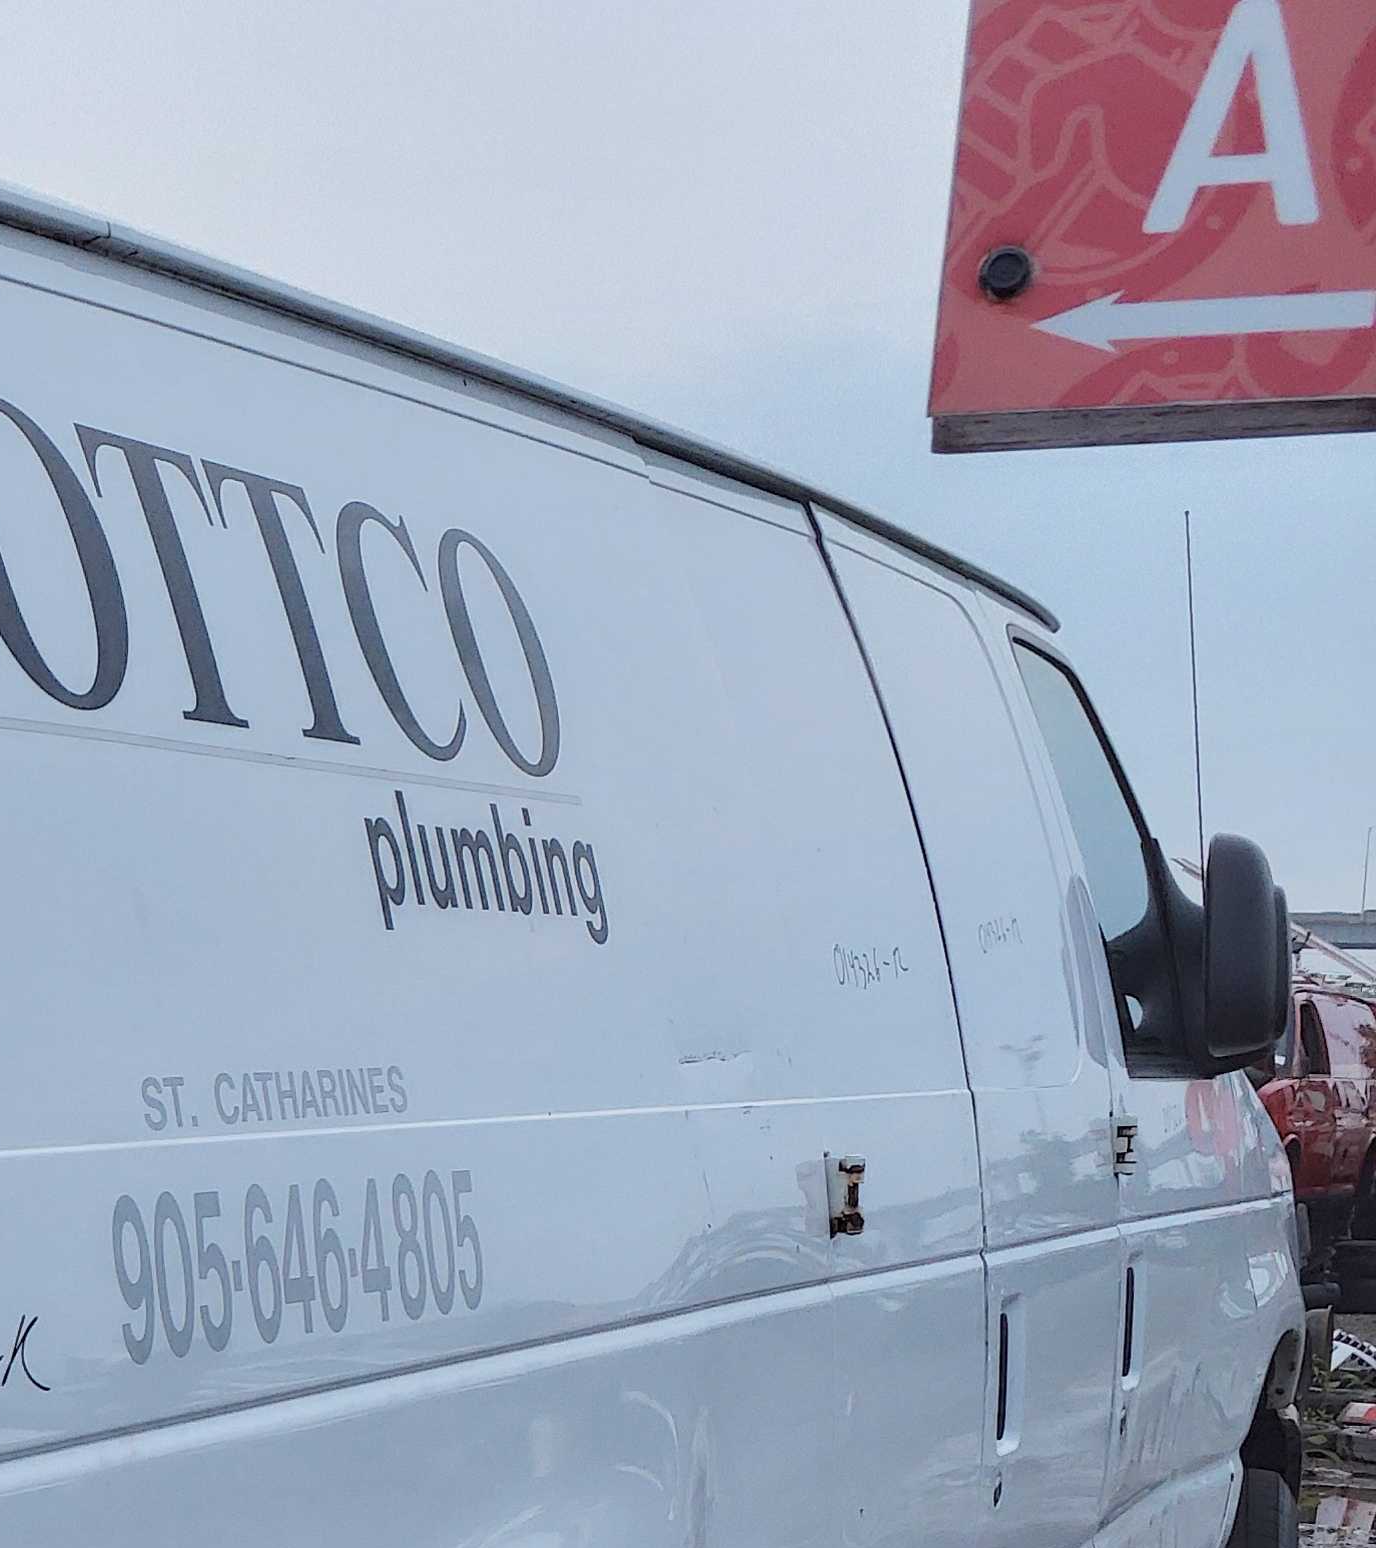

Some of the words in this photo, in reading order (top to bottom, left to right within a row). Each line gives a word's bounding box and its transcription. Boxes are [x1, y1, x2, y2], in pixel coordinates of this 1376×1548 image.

[1141, 0, 1320, 234] A
[364, 790, 608, 946] plumbing
[141, 1075, 200, 1132] ST.
[213, 1065, 409, 1126] CATHARINES
